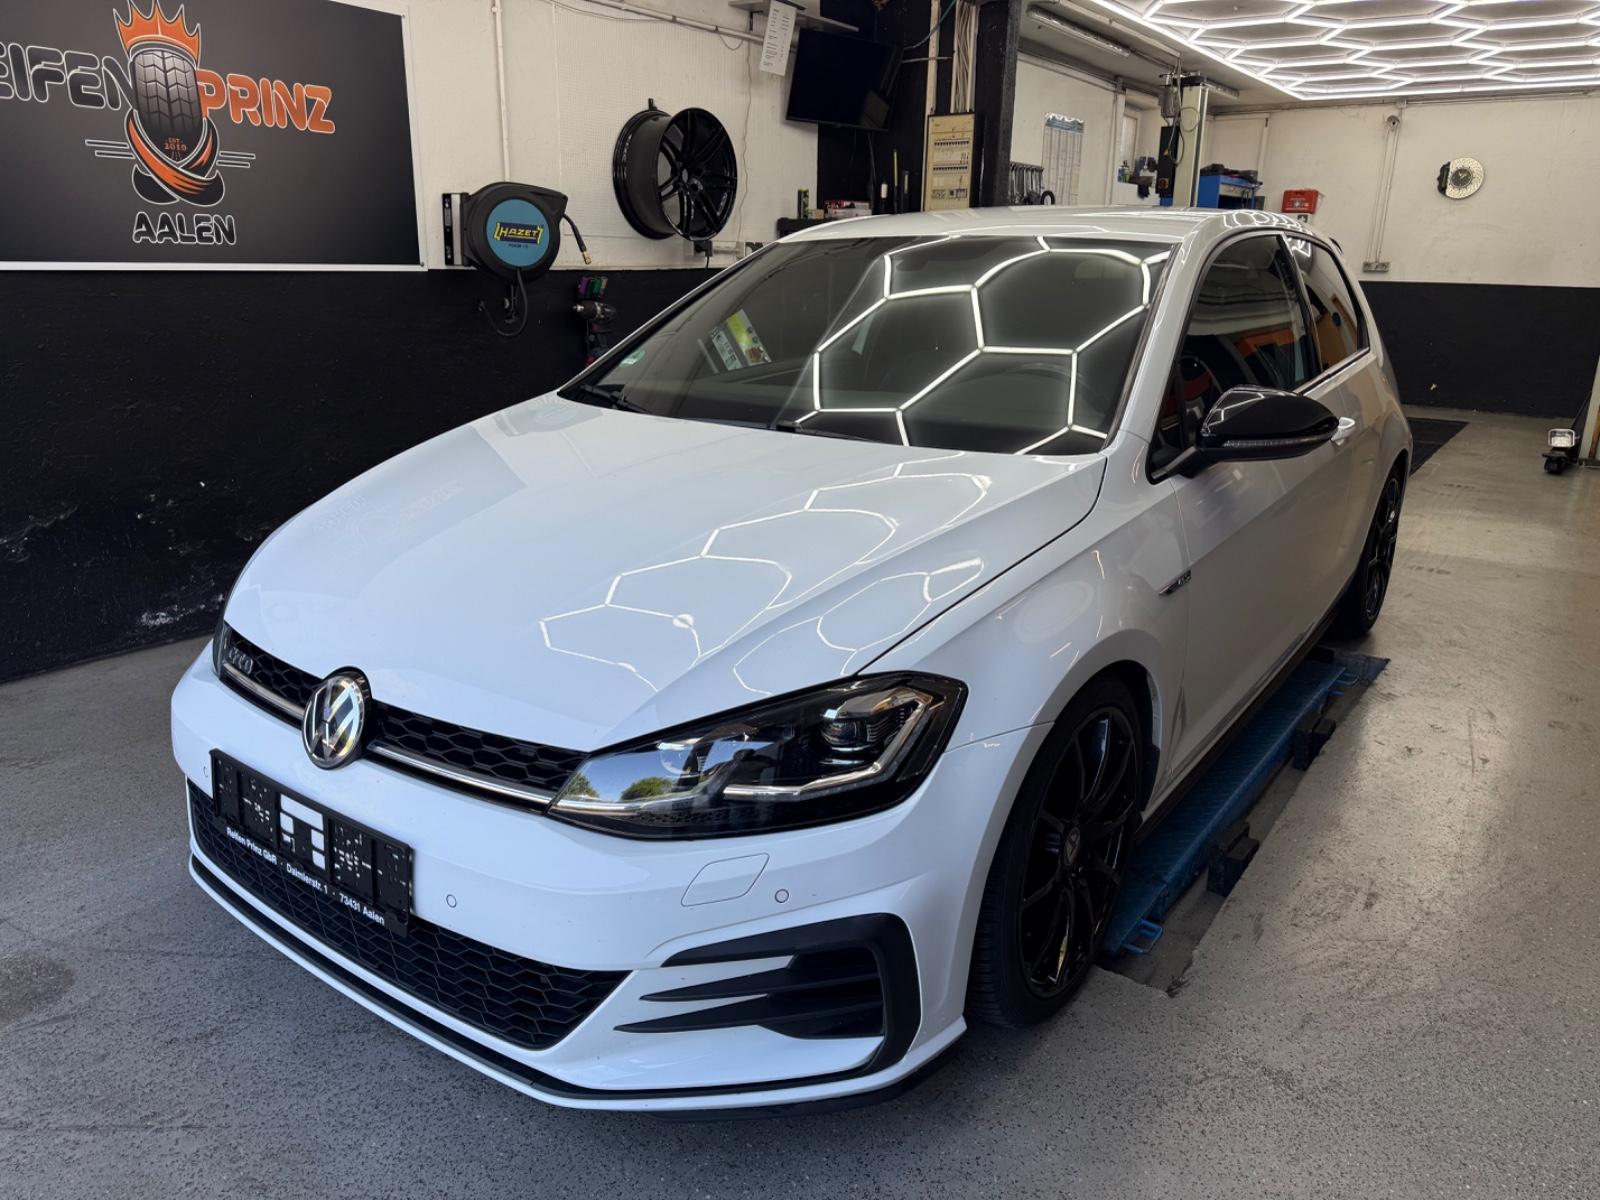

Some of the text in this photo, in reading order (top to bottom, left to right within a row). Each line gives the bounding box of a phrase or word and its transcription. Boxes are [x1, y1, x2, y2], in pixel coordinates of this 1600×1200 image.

[195, 68, 335, 133] PRINZ
[132, 211, 237, 246] AALEN
[499, 226, 539, 237] HAZET
[363, 905, 385, 926] Aalen
